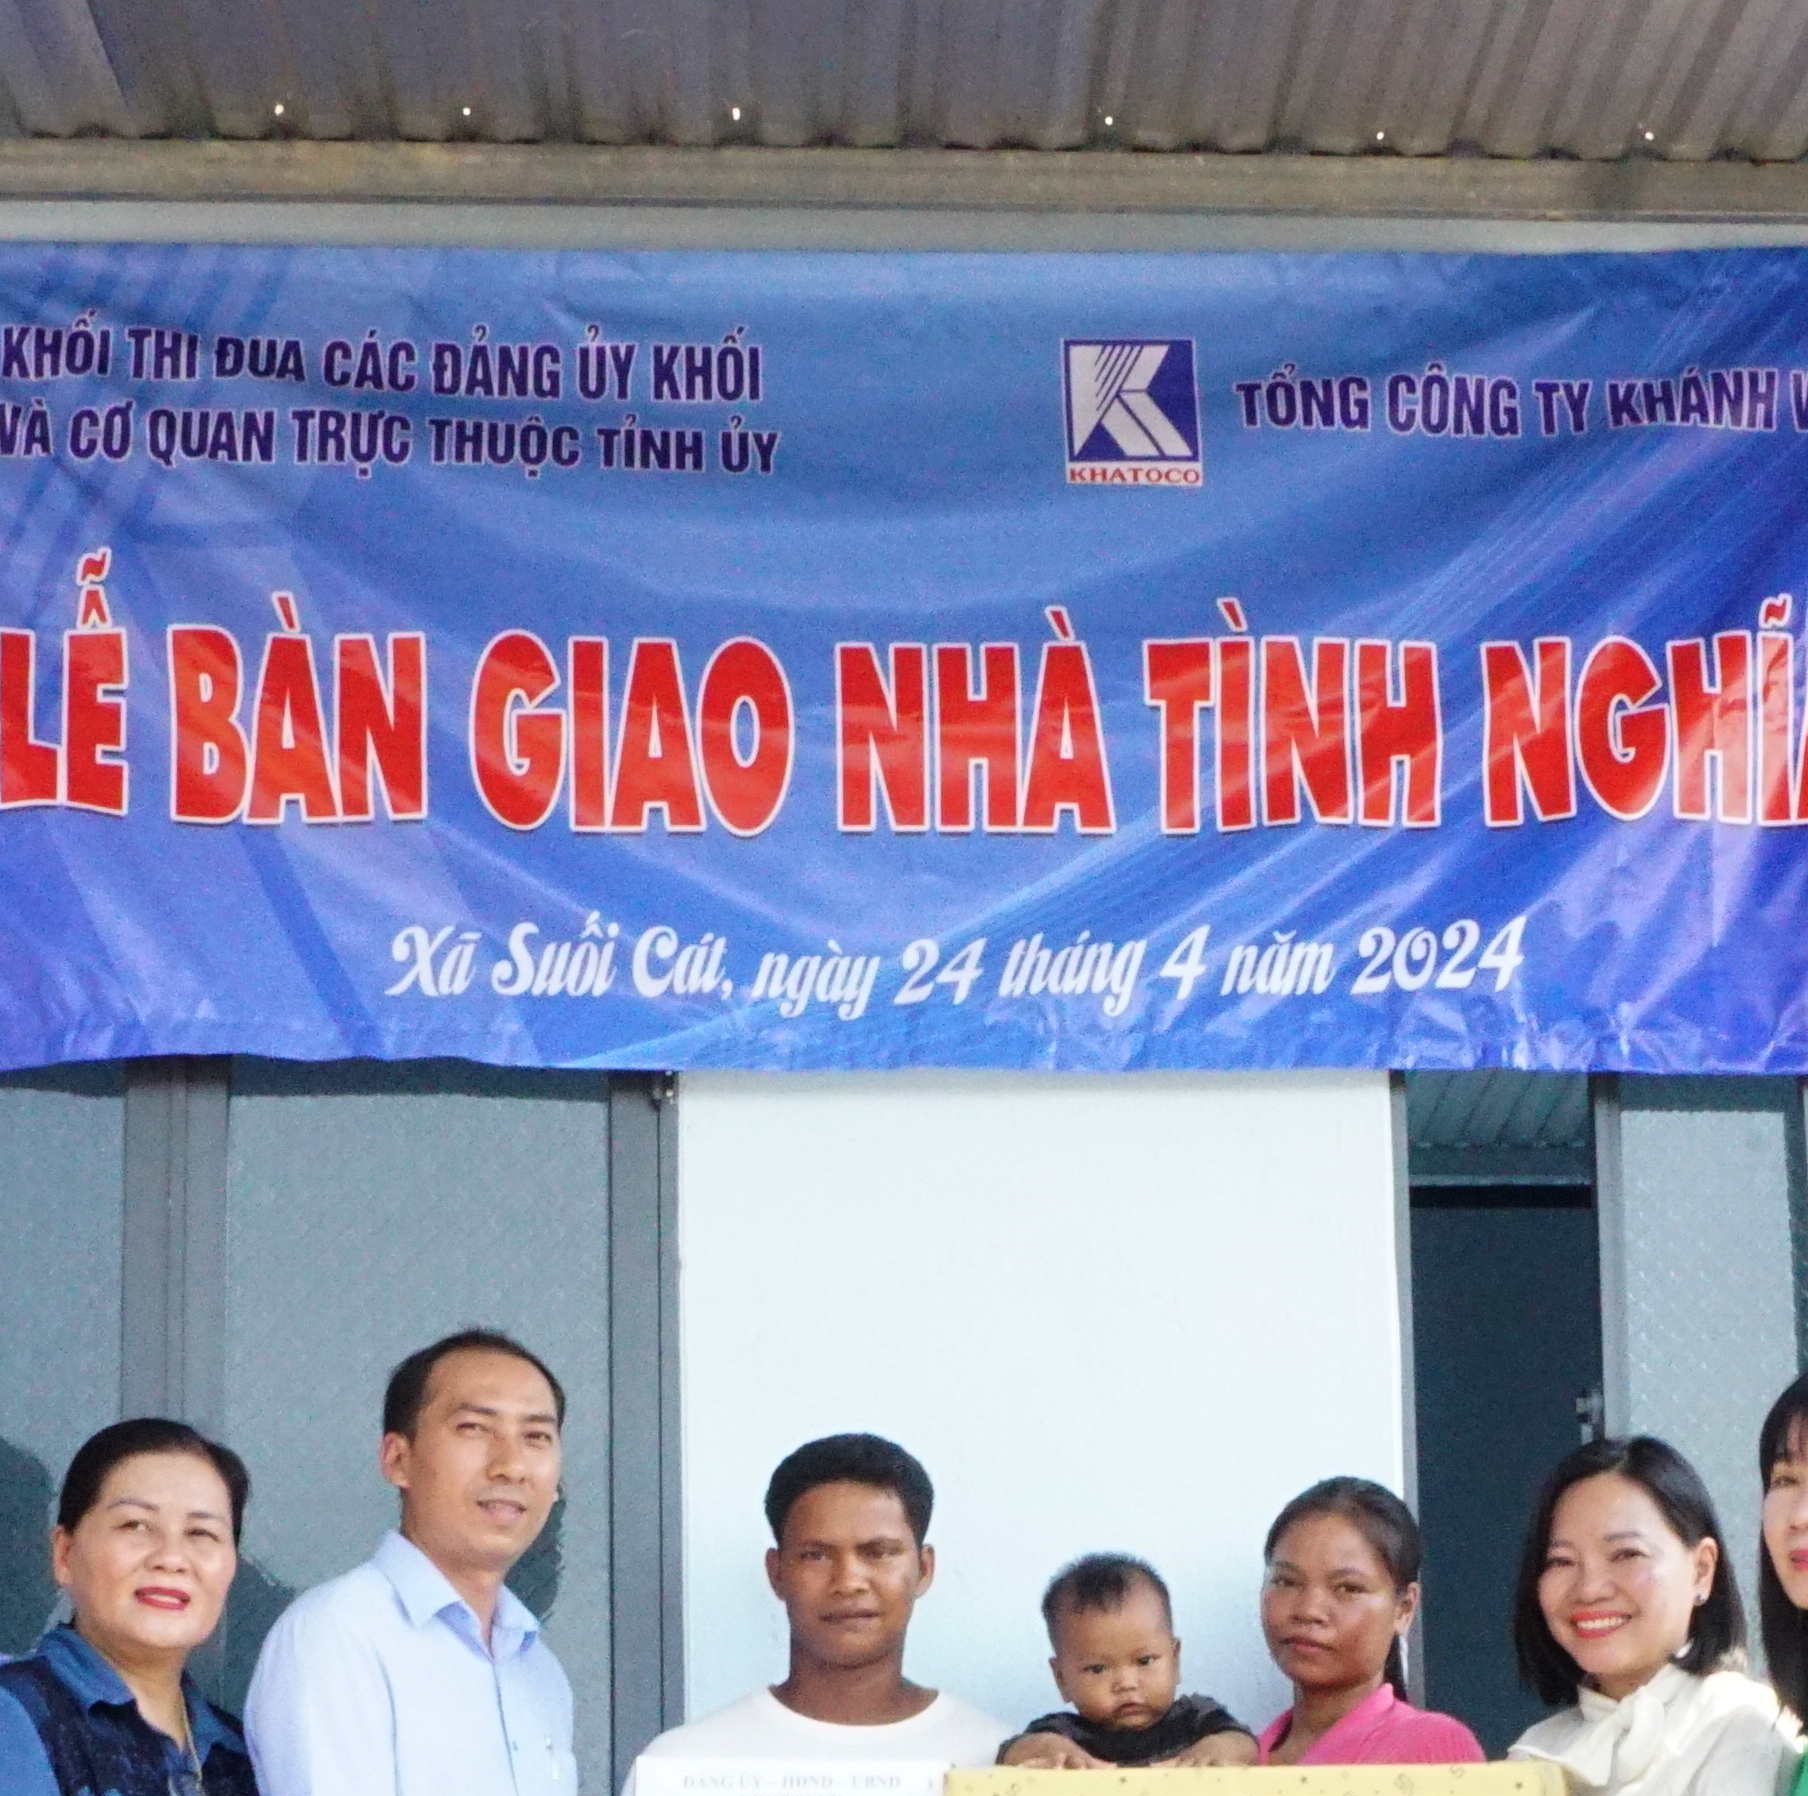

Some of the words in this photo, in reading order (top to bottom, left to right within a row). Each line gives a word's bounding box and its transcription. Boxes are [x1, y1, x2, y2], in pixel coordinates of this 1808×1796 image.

[0, 309, 113, 380] KHỐI
[126, 326, 200, 380] THI
[213, 335, 306, 382] ĐUA
[322, 329, 418, 391] CÁC
[430, 323, 563, 399] ĐẢNG
[577, 323, 638, 401] ỦY
[650, 326, 764, 402] KHỐI
[68, 400, 136, 461] CƠ
[147, 408, 276, 468] QUAN
[291, 409, 411, 479] TRỰC
[428, 414, 581, 480] THUỘC
[597, 413, 705, 472] TỈNH
[719, 413, 781, 475] ỦY
[1234, 362, 1372, 432] TỔNG
[1387, 361, 1521, 439] CÔNG
[1533, 378, 1592, 436] TY
[1606, 365, 1780, 432] KHÁNH
[1068, 465, 1201, 485] KHATOCO
[167, 590, 427, 825] BÀN
[469, 628, 795, 836] GIAO
[834, 605, 1118, 835] NHÀ
[1143, 598, 1443, 835] TÌNH
[384, 923, 482, 998] Xã
[491, 910, 620, 998] Suối
[631, 924, 734, 1001] Cát,
[751, 938, 881, 1021] ngày
[893, 936, 987, 1006] 24
[998, 929, 1148, 1018] tháng
[1159, 924, 1211, 1001] 4
[1219, 929, 1337, 998] năm
[1350, 914, 1528, 996] 2024
